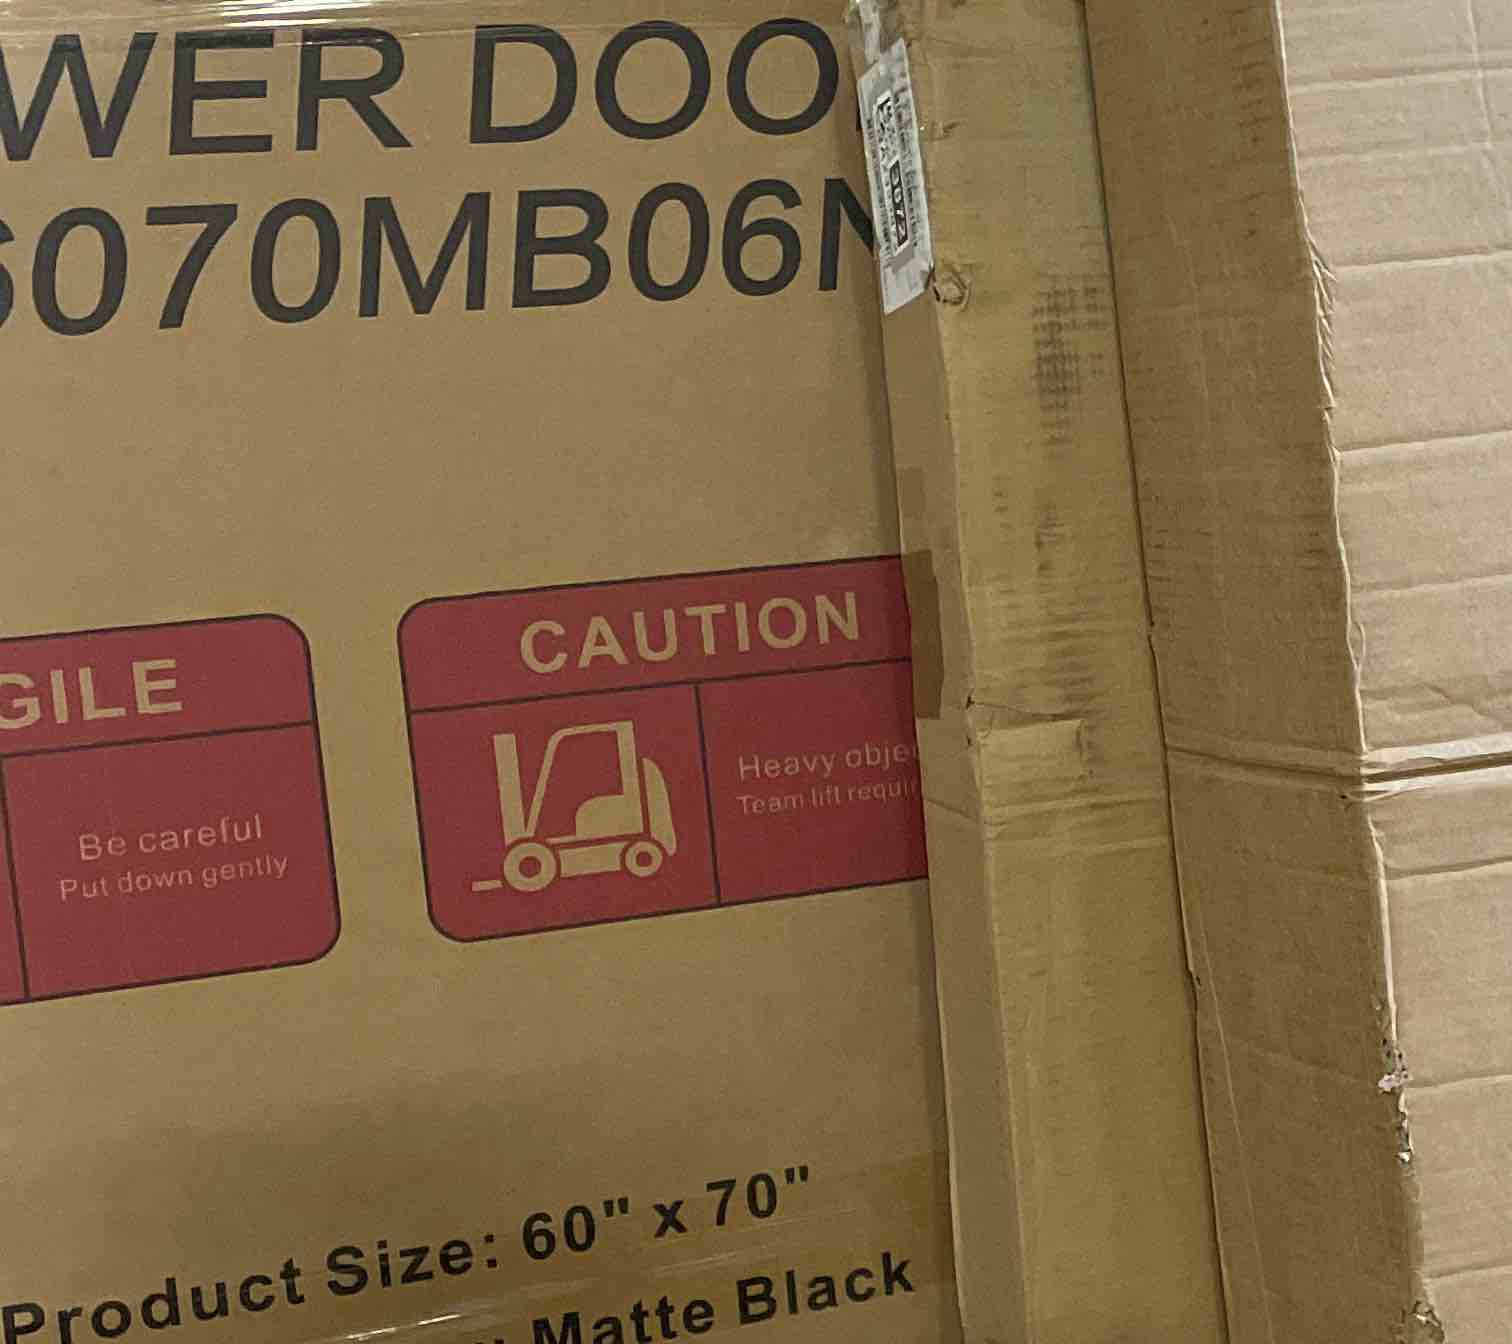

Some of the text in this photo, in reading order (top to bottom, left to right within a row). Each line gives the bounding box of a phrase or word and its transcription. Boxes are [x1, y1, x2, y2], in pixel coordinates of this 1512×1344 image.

[467, 16, 863, 147] DOO
[0, 176, 875, 337] 070MB06N
[520, 591, 860, 674] CAUTION
[735, 779, 917, 816] Team lift requi
[738, 751, 836, 783] Heavy
[78, 813, 264, 861] Be careful
[60, 853, 289, 902] Put down gently
[325, 1233, 499, 1297] Size:
[521, 1197, 630, 1261] 60"
[652, 1199, 689, 1240] x
[706, 1164, 811, 1227] 70"
[736, 1250, 916, 1326] Black
